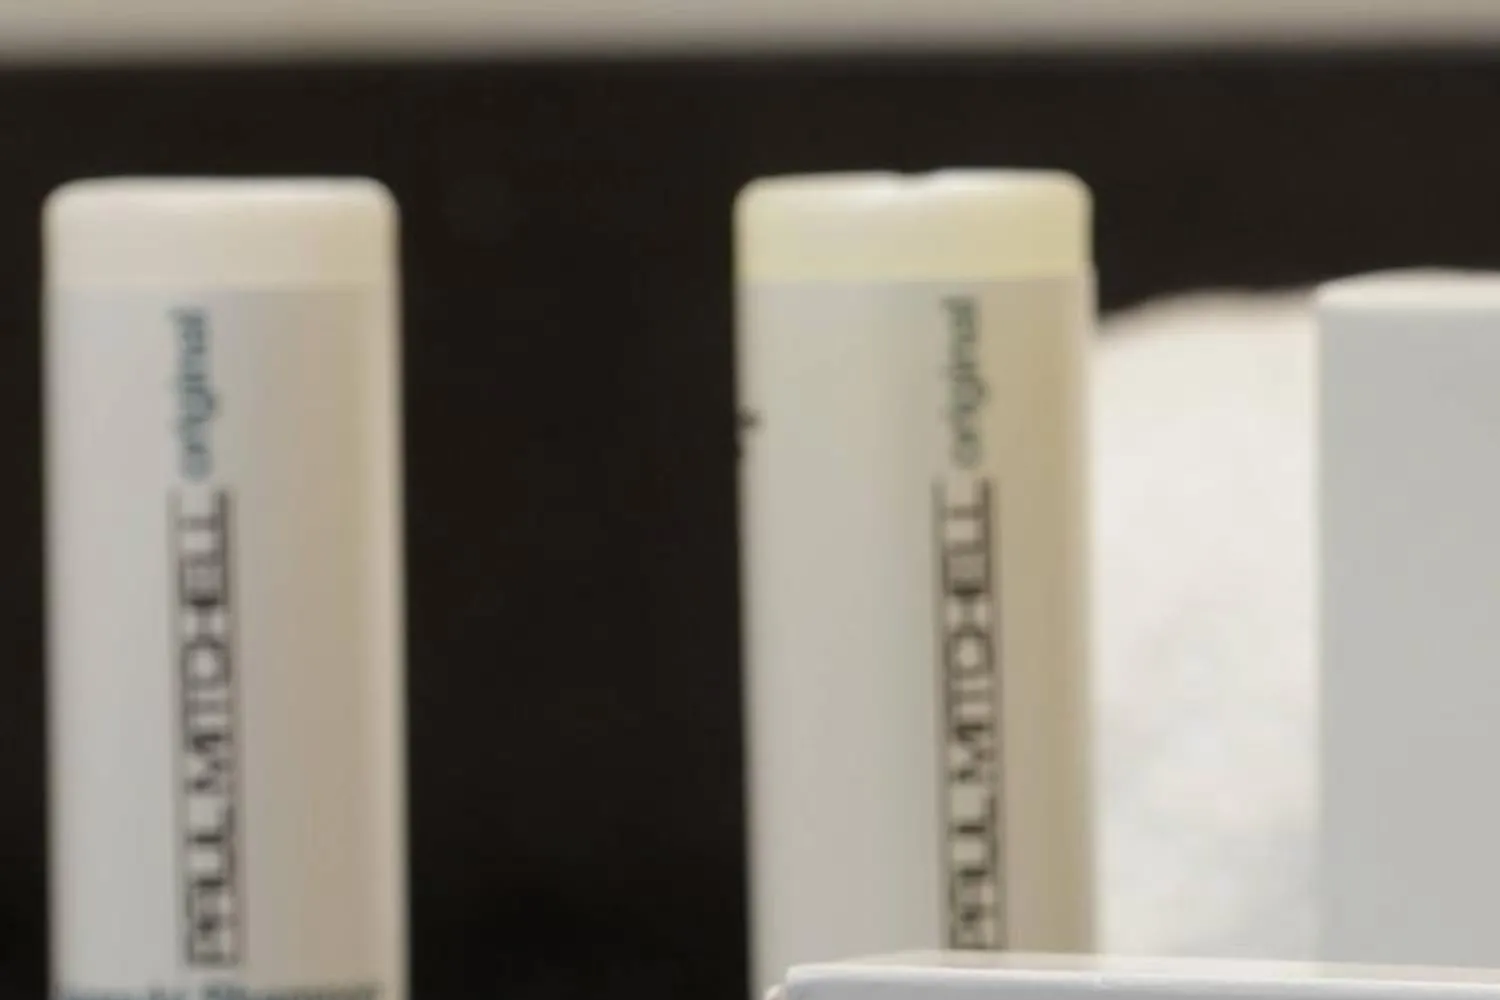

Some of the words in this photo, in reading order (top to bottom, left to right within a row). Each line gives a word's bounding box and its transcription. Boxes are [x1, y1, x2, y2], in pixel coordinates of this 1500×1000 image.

[179, 488, 233, 796] MITCHELL
[943, 479, 996, 783] MITCHELL
[185, 803, 236, 968] PAUL
